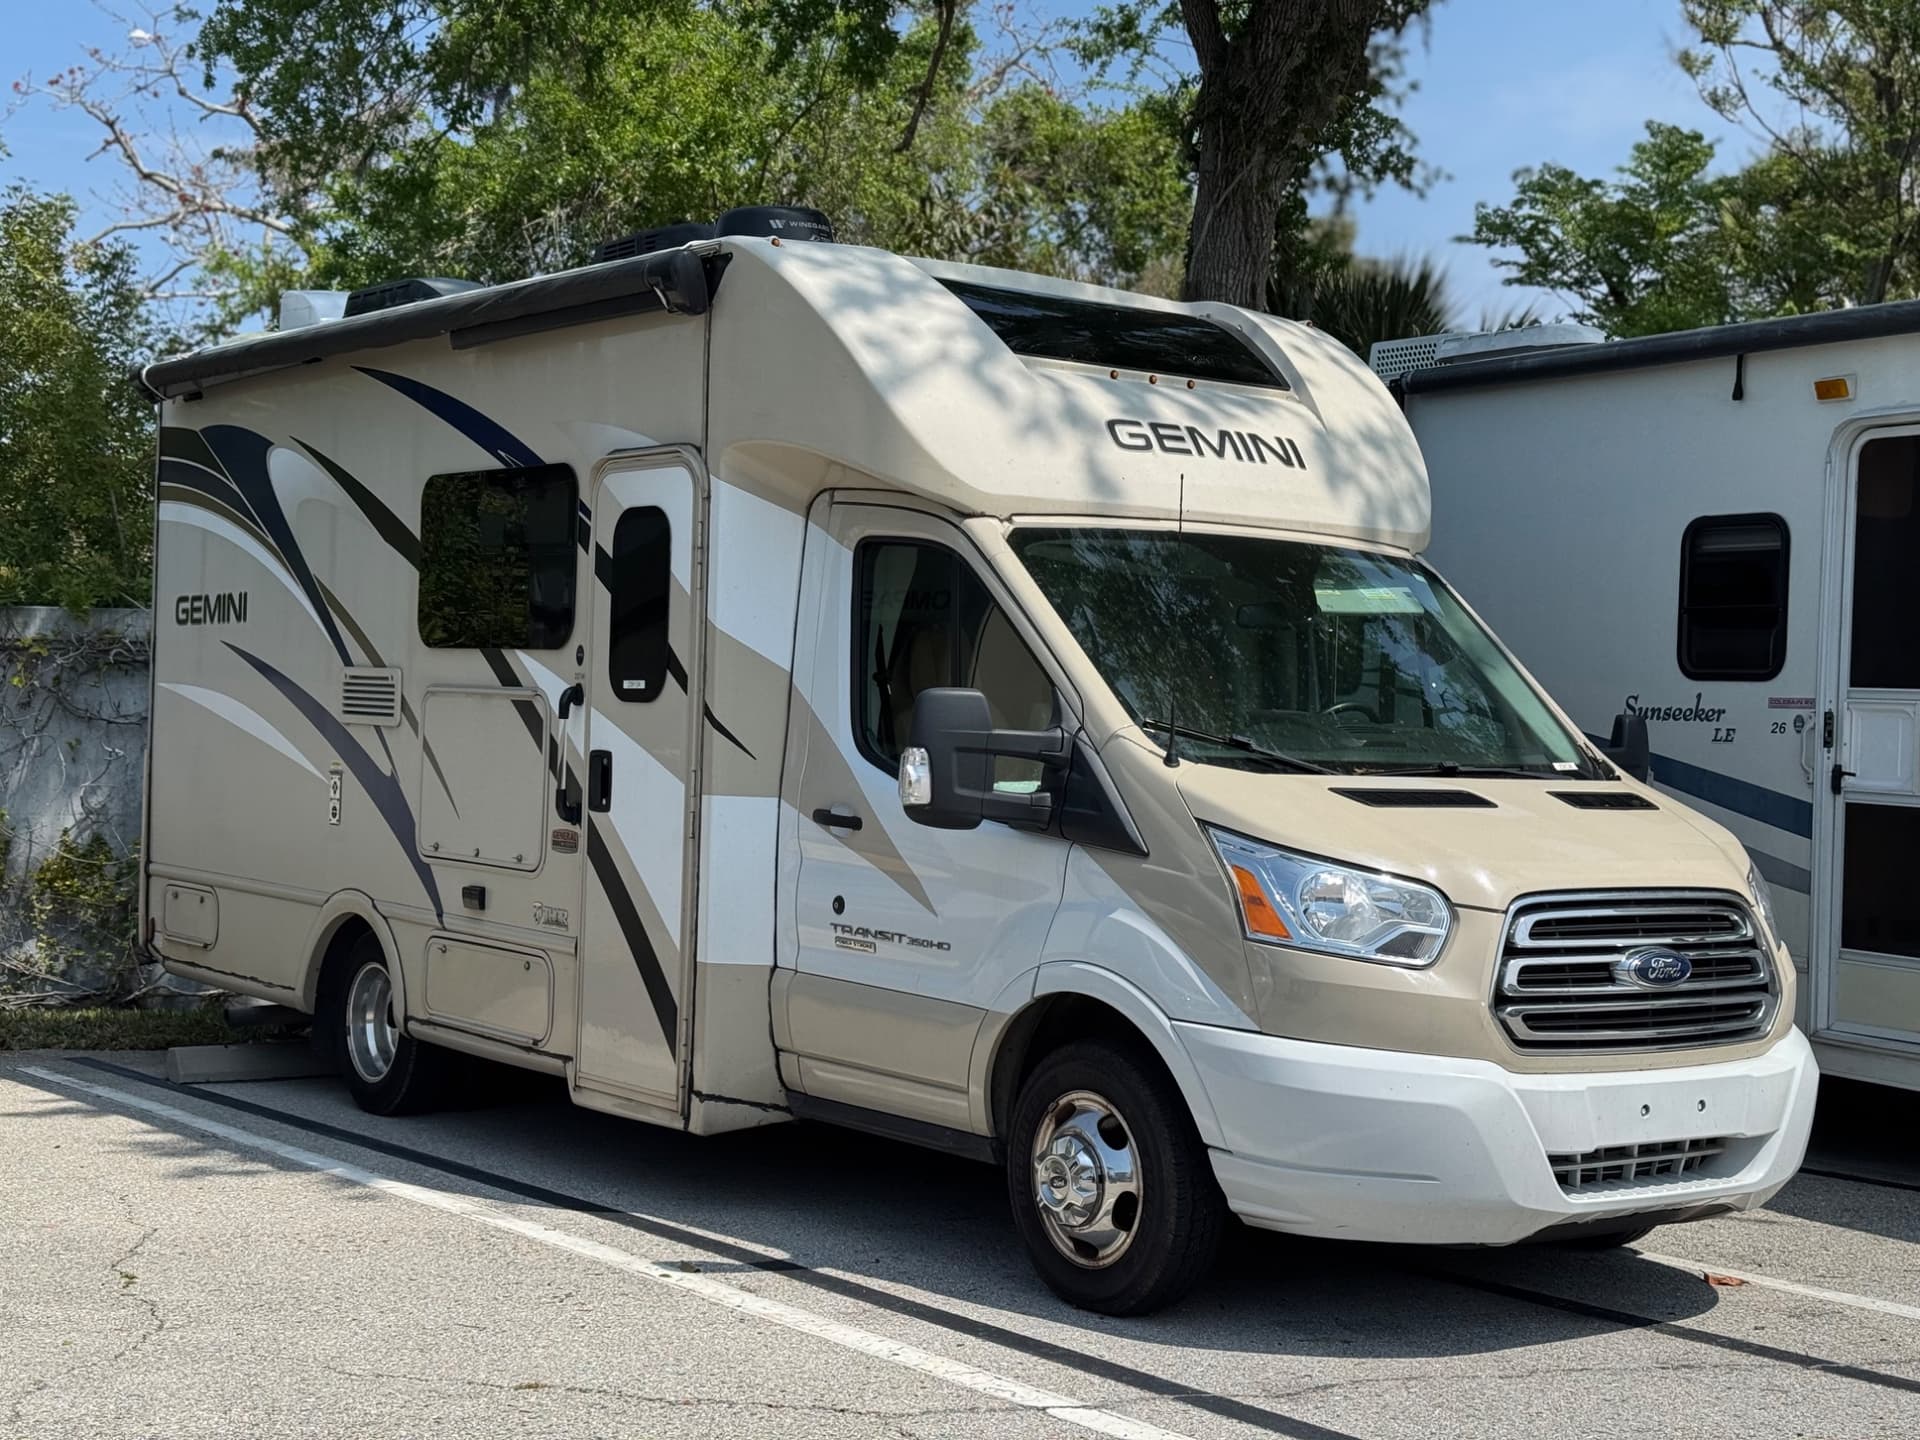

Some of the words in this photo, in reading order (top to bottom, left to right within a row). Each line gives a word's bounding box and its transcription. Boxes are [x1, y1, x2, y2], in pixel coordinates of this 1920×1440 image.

[1107, 419, 1307, 470] GEMINI
[175, 591, 248, 626] GEMINI
[1625, 692, 1726, 722] Sunseeker
[1712, 728, 1736, 743] LE
[1771, 721, 1787, 734] 26
[830, 922, 907, 943] TRANSIT
[1648, 957, 1681, 979] Ford
